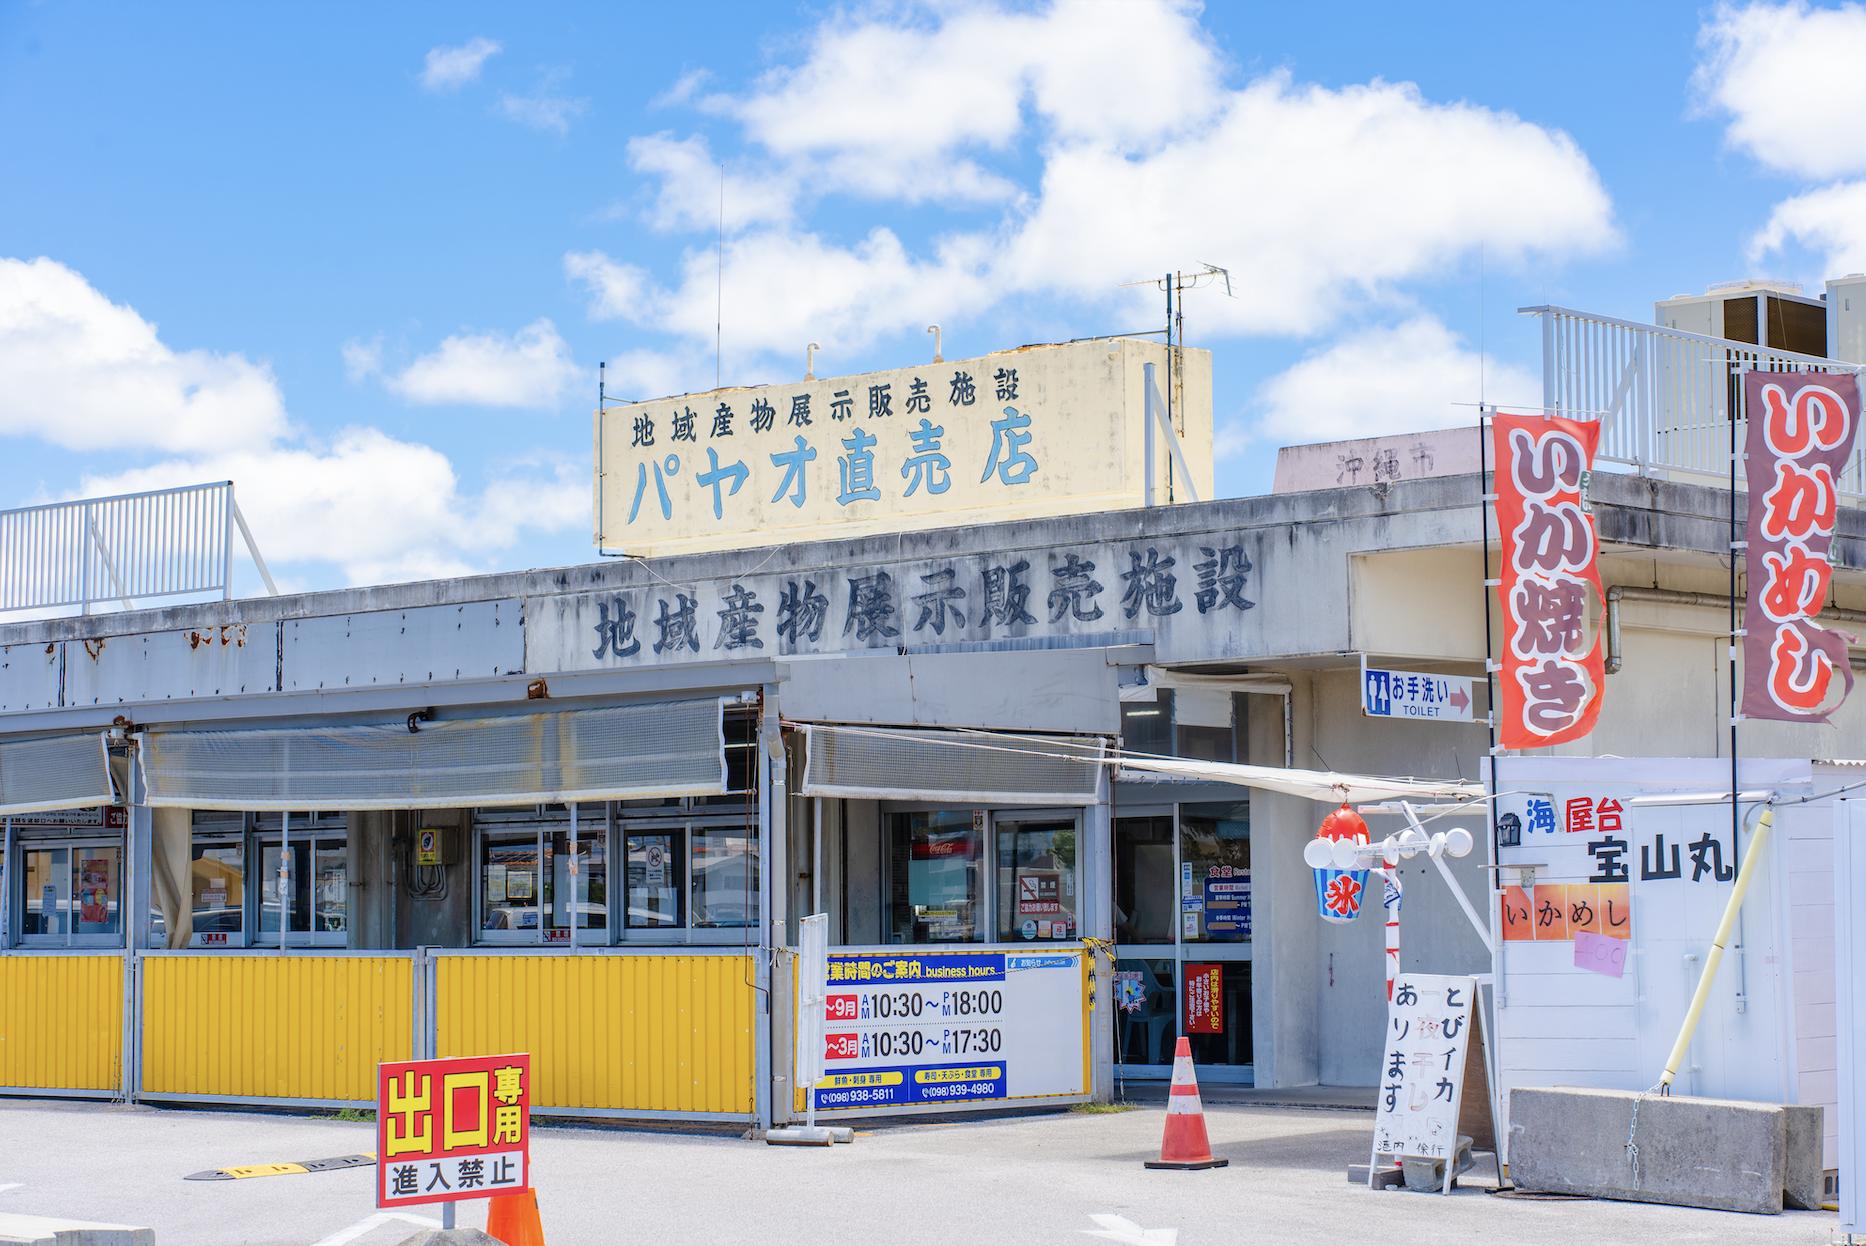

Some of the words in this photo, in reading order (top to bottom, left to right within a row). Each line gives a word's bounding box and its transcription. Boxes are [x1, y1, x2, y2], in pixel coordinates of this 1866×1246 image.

[631, 368, 1020, 447] 地域産物展示販売施設
[628, 406, 1039, 525] パヤオ直売店
[1509, 428, 1594, 736] いか焼き
[1759, 383, 1850, 715] いかめし
[593, 543, 1257, 660] 地域産物展示販売施設
[1392, 675, 1448, 702] お手洗い
[1403, 705, 1440, 717] TOILET
[1325, 875, 1361, 915] 氷
[1588, 832, 1734, 883] 宝山丸
[1506, 899, 1627, 927] いかめし
[826, 960, 922, 981] 業時間のご案内
[925, 965, 967, 977] business
[968, 964, 995, 976] hours
[1385, 983, 1418, 1113] あります
[1433, 988, 1465, 1103] とびイカ
[386, 1070, 489, 1157] 出口
[492, 1065, 524, 1145] 専用
[392, 1156, 516, 1196] 進入禁止
